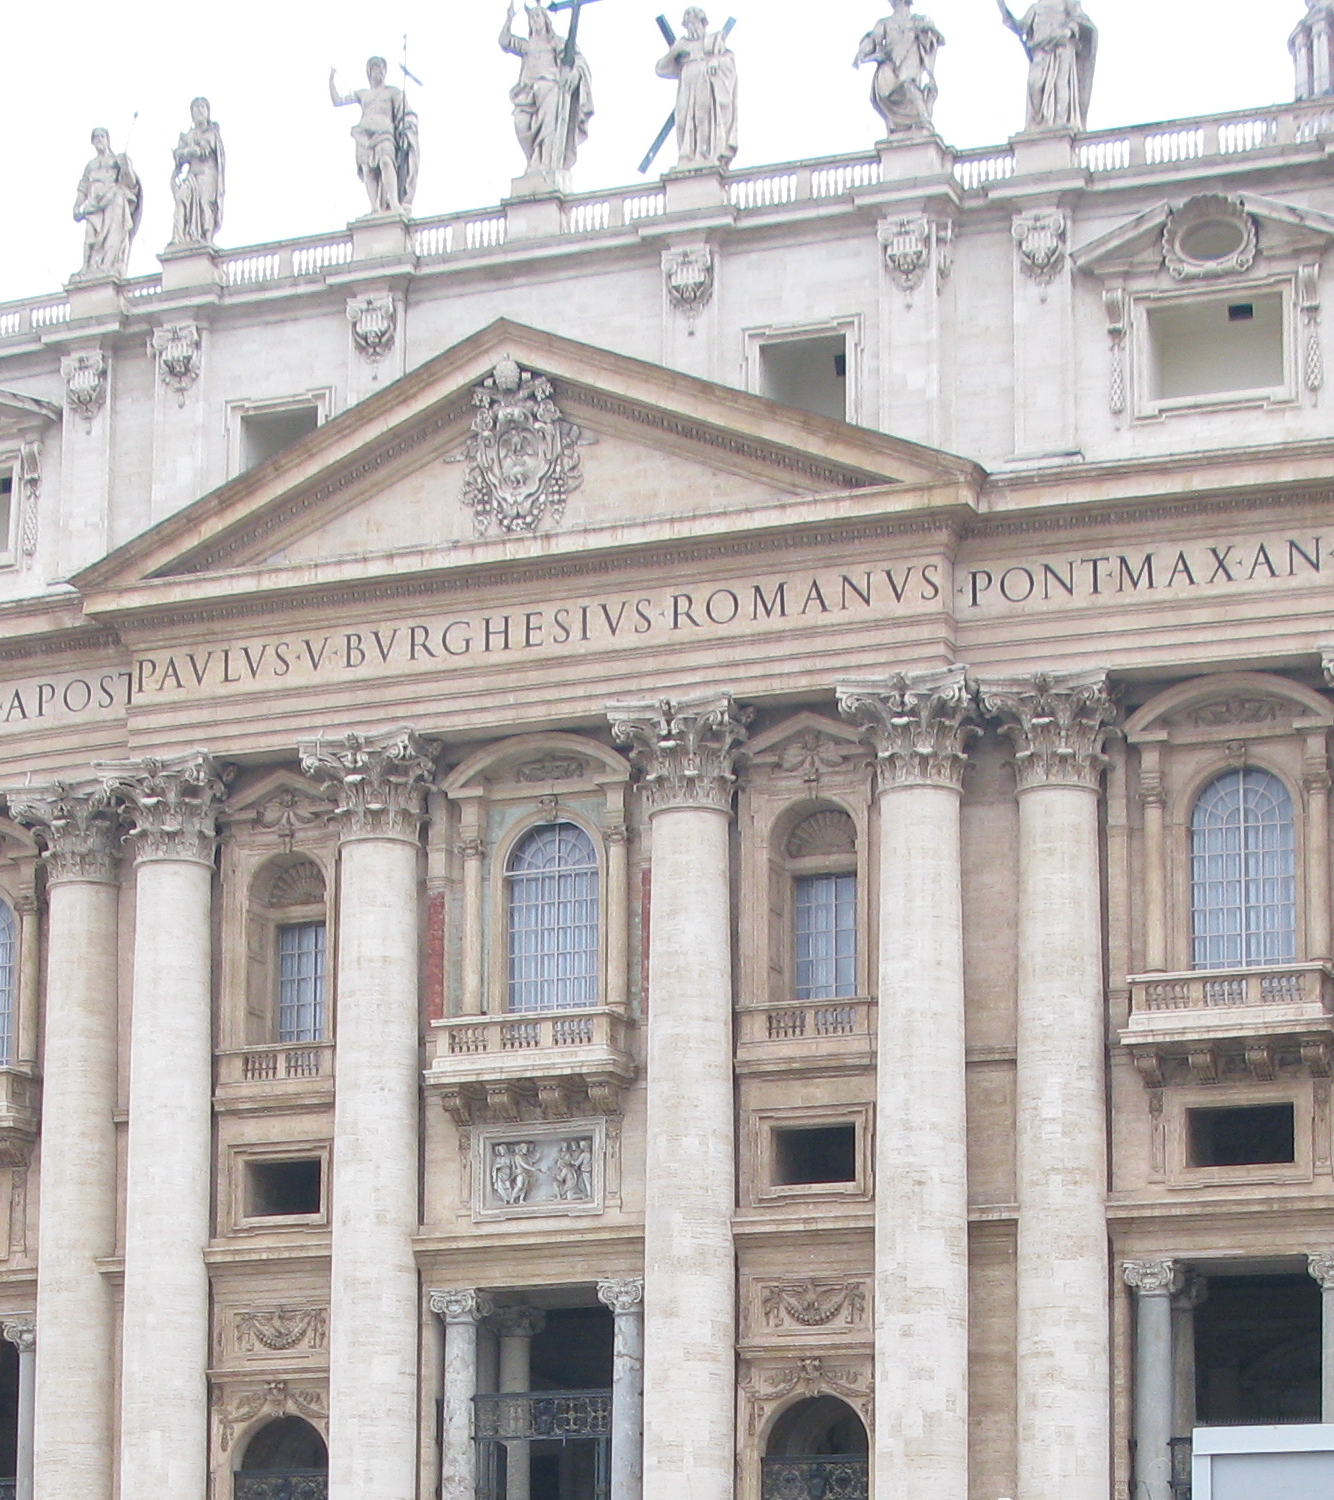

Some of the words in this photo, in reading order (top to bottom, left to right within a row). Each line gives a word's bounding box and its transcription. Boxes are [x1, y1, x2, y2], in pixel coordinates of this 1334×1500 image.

[136, 641, 291, 693] PAVLVS
[344, 598, 653, 668] BVRGHESIVS
[670, 564, 940, 629] ROMANVS
